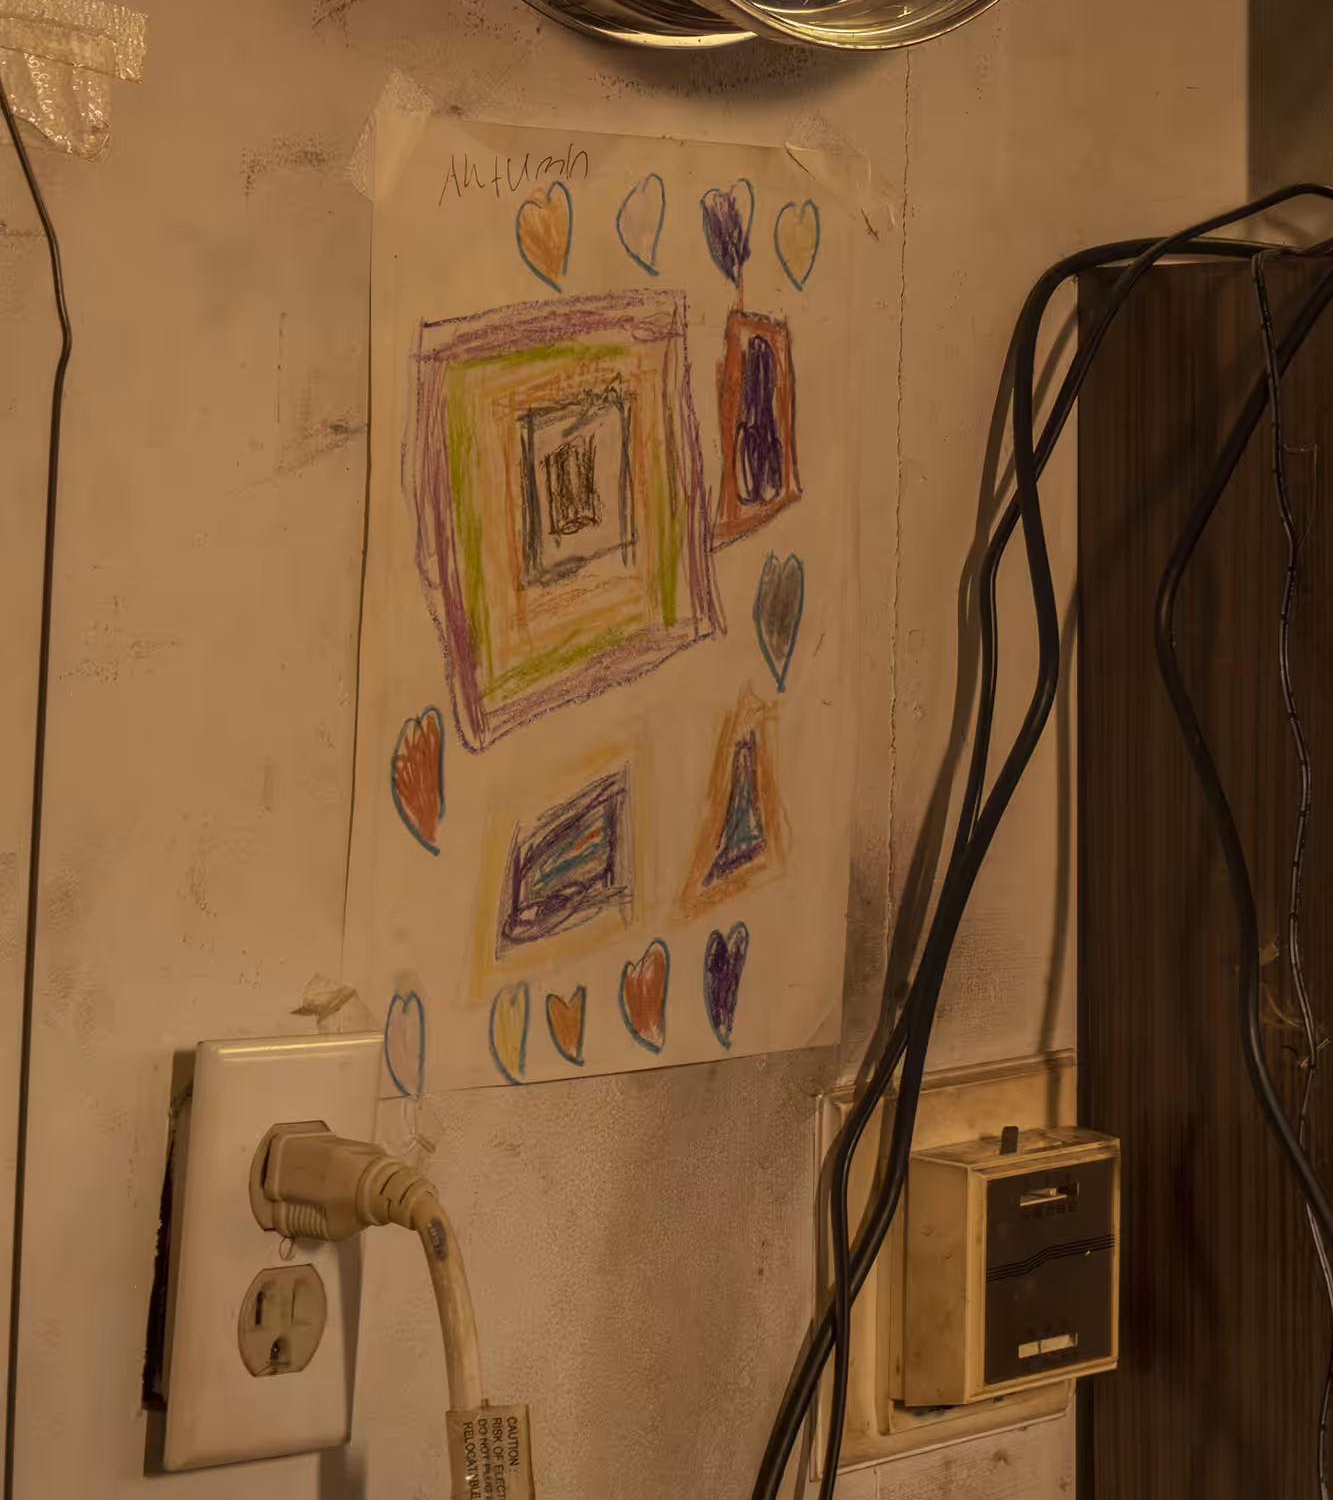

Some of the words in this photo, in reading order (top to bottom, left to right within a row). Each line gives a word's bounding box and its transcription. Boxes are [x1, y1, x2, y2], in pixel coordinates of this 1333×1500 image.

[478, 1419, 487, 1434] DO
[492, 1417, 503, 1443] RISK
[480, 1438, 489, 1460] NOT
[507, 1416, 520, 1466] CAUTION
[493, 1446, 504, 1460] OF
